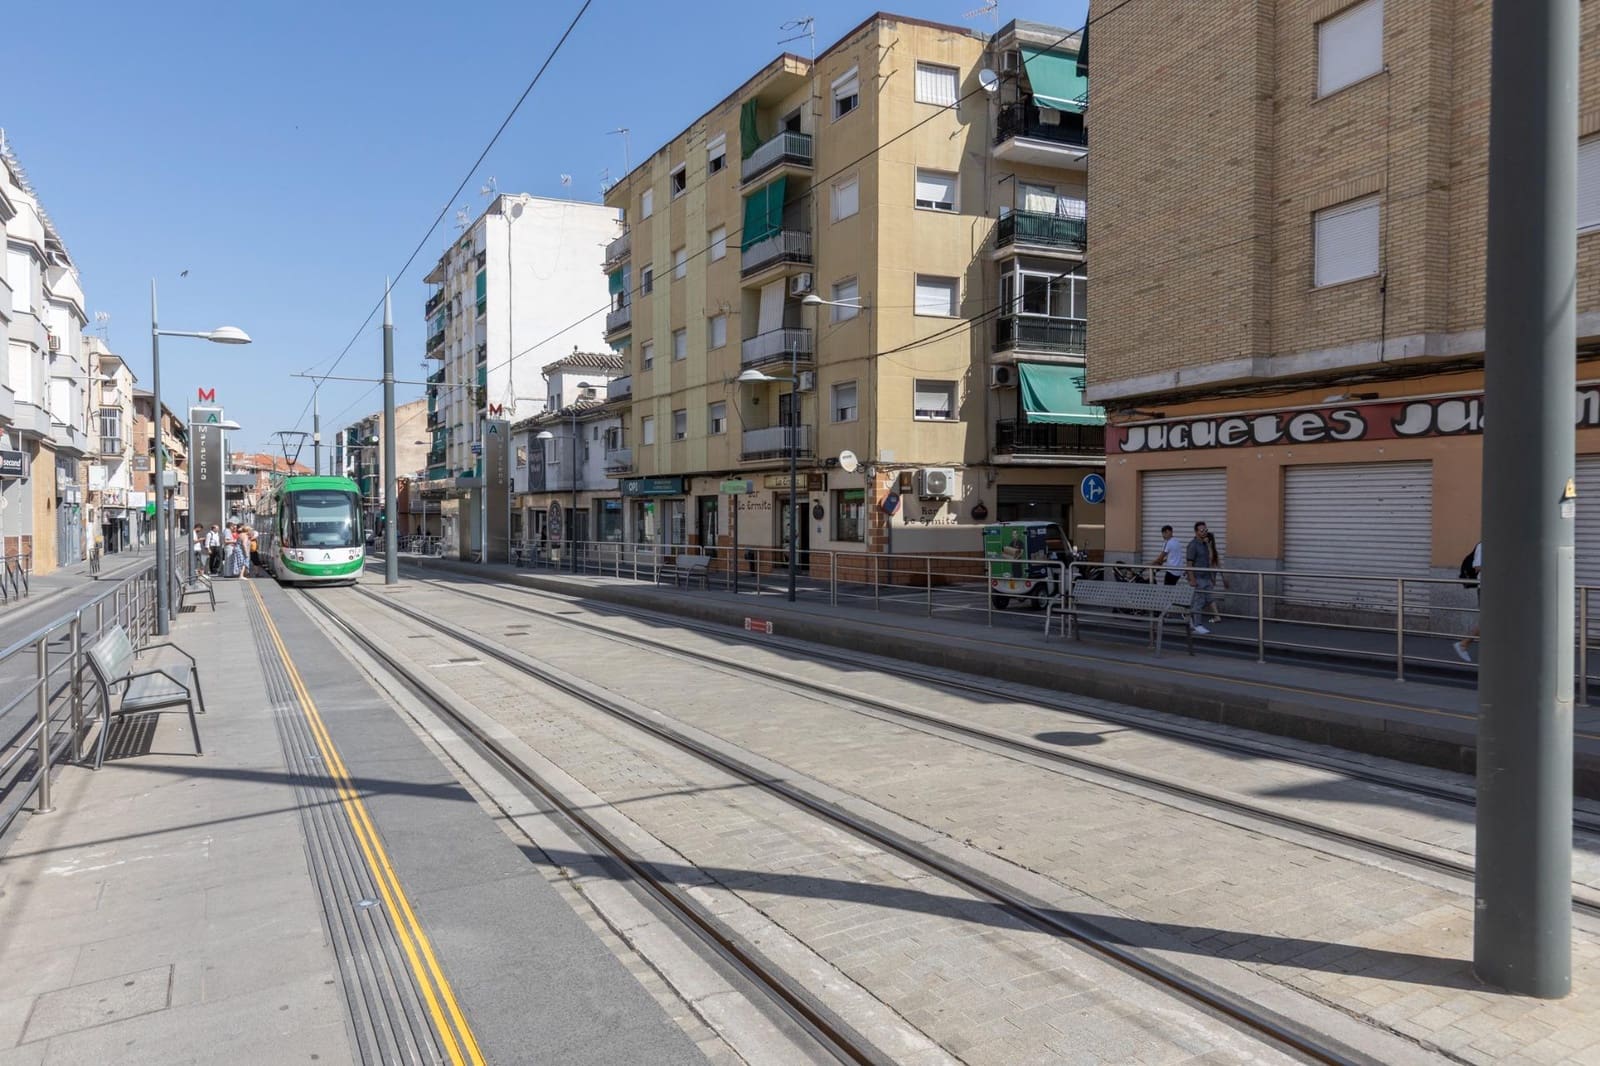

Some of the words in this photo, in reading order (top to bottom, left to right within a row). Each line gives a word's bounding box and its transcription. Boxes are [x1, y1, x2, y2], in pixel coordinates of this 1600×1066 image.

[198, 388, 215, 402] M
[489, 403, 503, 417] M
[198, 425, 208, 480] Maracena
